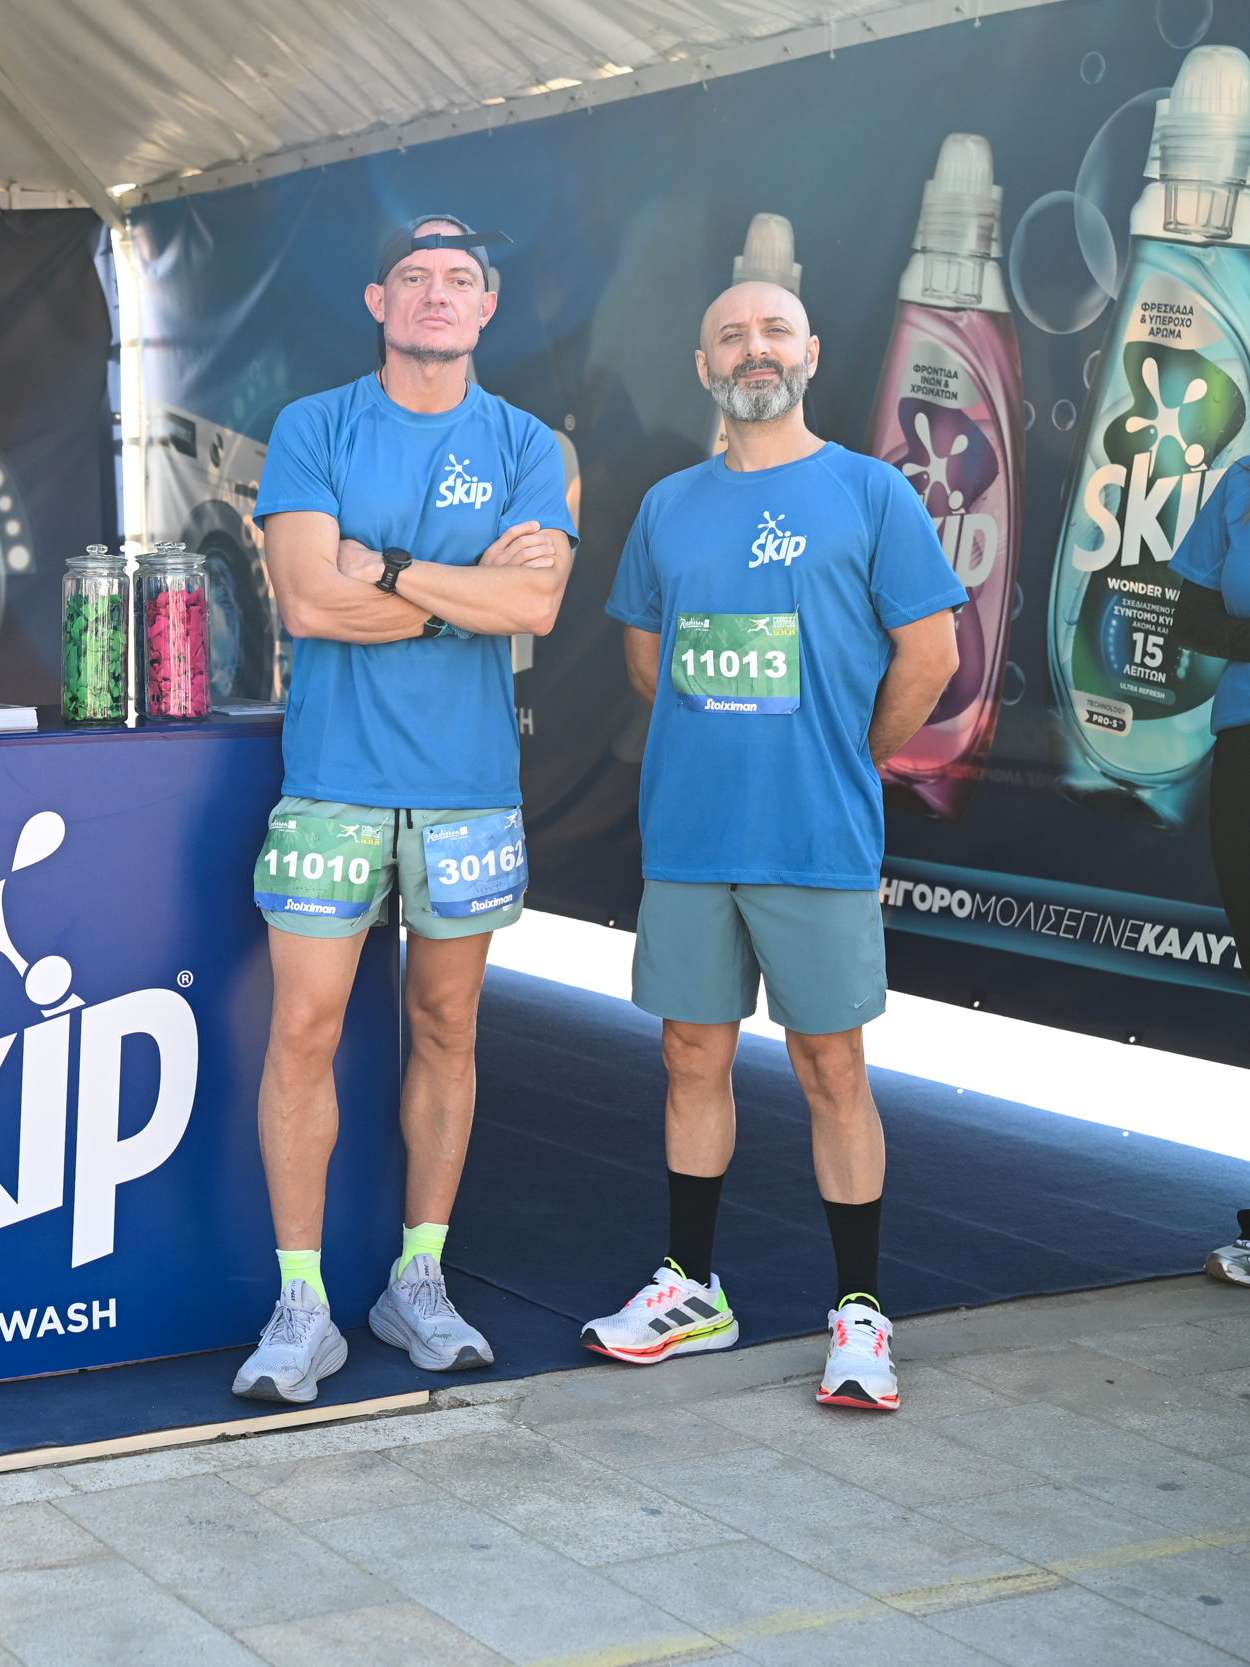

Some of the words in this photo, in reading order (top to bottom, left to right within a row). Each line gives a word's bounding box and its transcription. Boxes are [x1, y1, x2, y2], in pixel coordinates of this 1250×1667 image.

[1140, 302, 1194, 316] ΦΡΕΣΚΑΔΑ
[1149, 315, 1192, 328] ΥΠΕΡΟΧΟ
[1148, 327, 1182, 339] ΑΡΩΜΑ
[913, 364, 958, 380] ΦΡΟΝΤΙΔΑ
[921, 376, 941, 388] ΙΝΩΝ
[910, 383, 958, 401] ΧΡΩΜΑΤΩΝ
[436, 476, 493, 509] Skip
[748, 530, 807, 569] Skip
[1107, 577, 1162, 598] WONDER
[1113, 606, 1158, 623] ΣΥΝΤΟΜΟ
[1122, 598, 1170, 615] ΣΧΕΔΙΑΣΜΕΝΟ
[1132, 621, 1156, 632] ΑΚΟΜΑ
[1157, 626, 1169, 635] ΚΑΙ
[1132, 632, 1164, 668] 15
[681, 649, 787, 678] 11013
[1123, 664, 1166, 683] ΛΕΠΤΩΝ
[1120, 682, 1138, 694] ULTRA
[1139, 687, 1165, 699] REFRESH
[704, 698, 757, 711] Stoiximan
[1087, 699, 1126, 715] TECHNOLOGY
[1092, 713, 1118, 728] PRO-S
[264, 849, 370, 884] 11010
[438, 839, 524, 885] 30162
[285, 898, 336, 914] Stoiximan
[470, 894, 513, 913] Stoiximan
